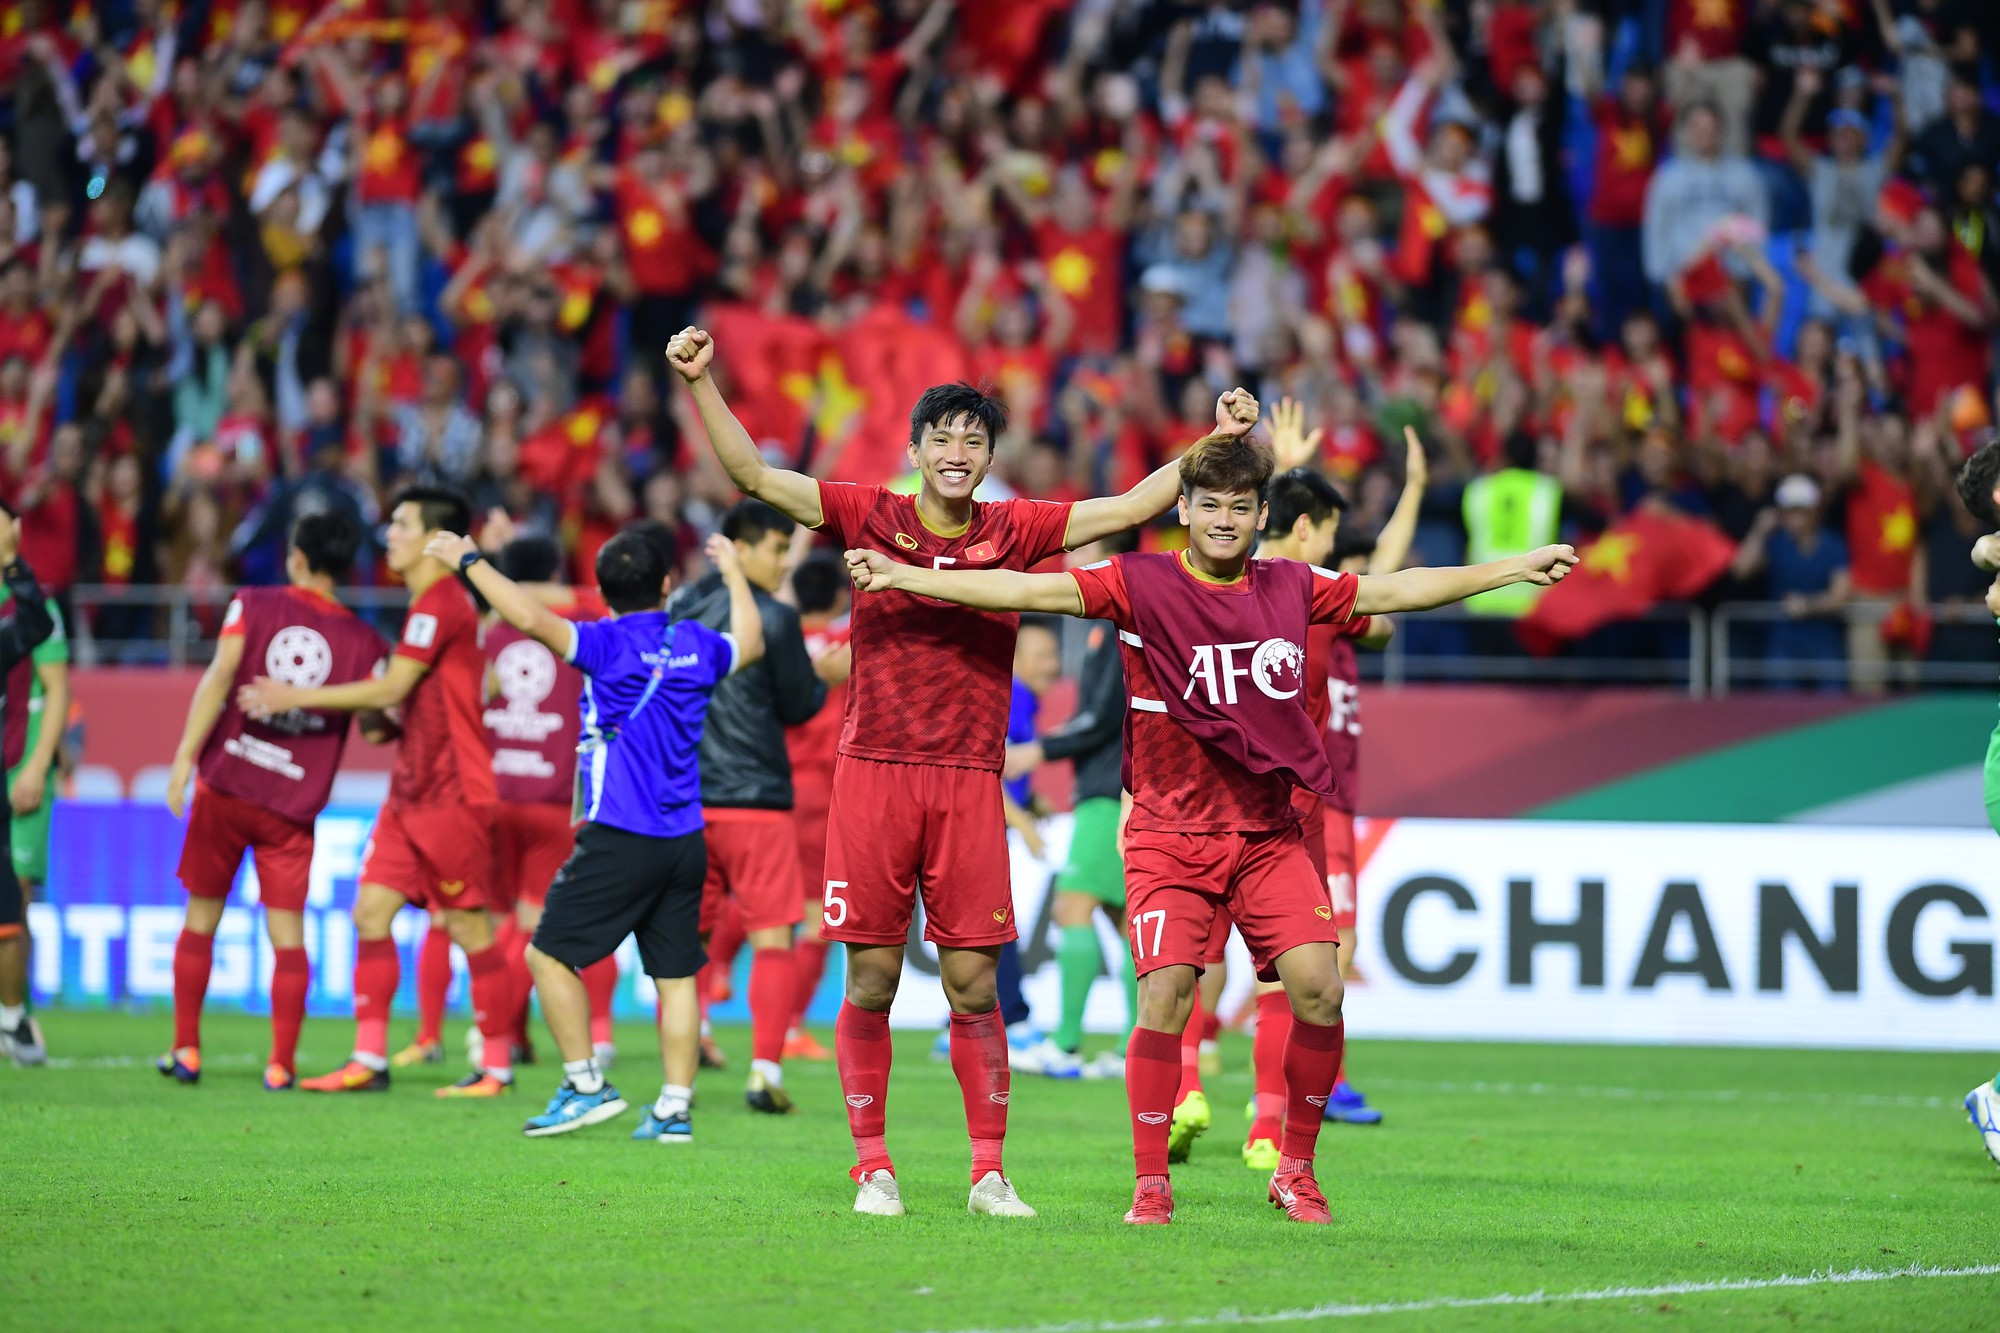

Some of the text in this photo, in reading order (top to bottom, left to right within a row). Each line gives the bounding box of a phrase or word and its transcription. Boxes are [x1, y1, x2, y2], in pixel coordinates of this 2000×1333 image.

[1183, 638, 1304, 704] AFC
[824, 880, 849, 927] 5
[1132, 909, 1166, 960] 17
[1382, 875, 1995, 998] CHANG
